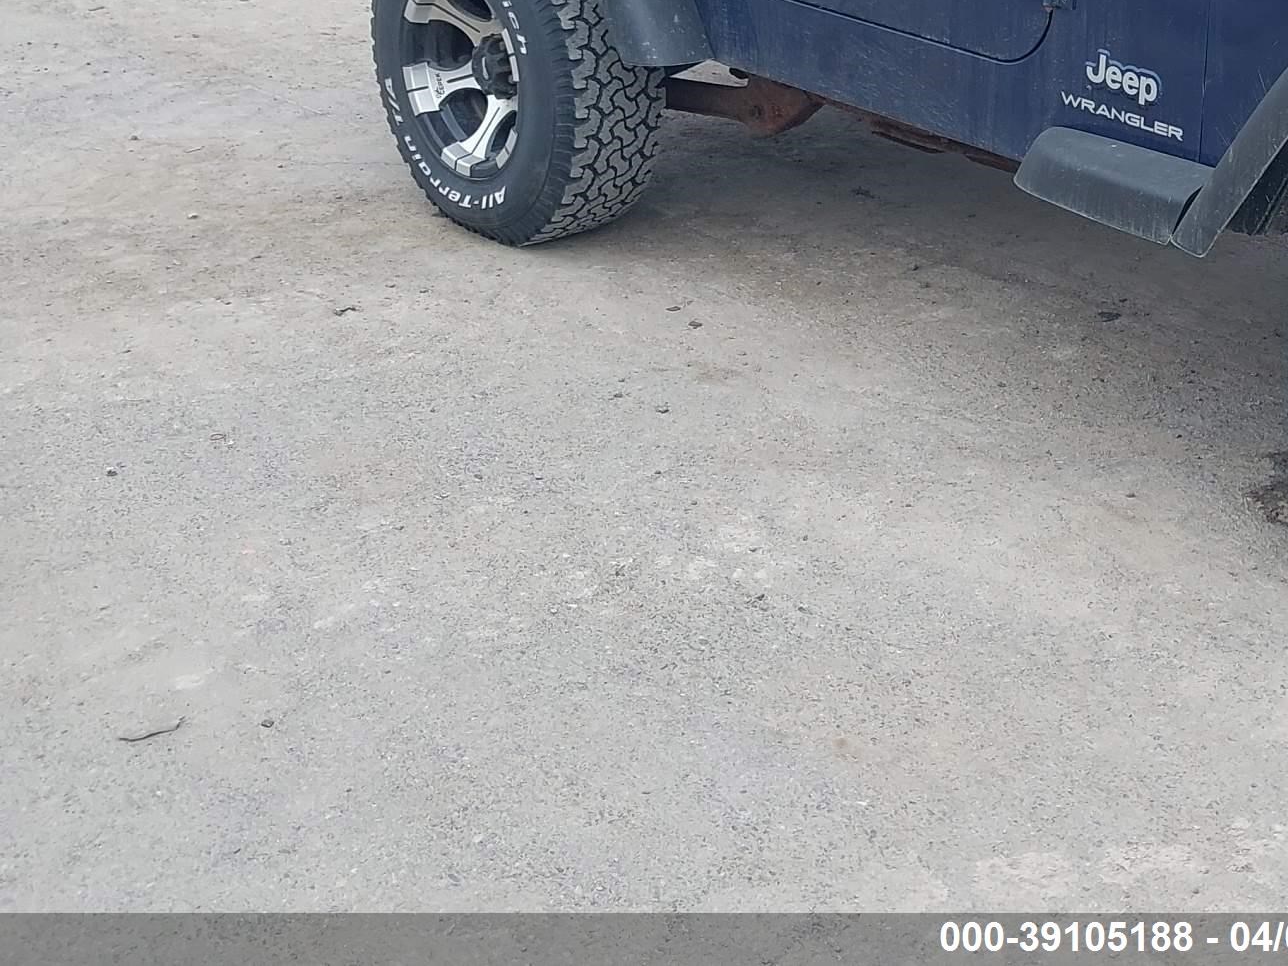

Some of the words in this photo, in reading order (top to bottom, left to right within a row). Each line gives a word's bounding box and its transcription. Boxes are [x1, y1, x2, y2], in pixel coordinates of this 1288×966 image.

[1086, 52, 1159, 106] Jeep
[1061, 90, 1183, 142] WRANGLER
[404, 135, 508, 210] All-Terrain
